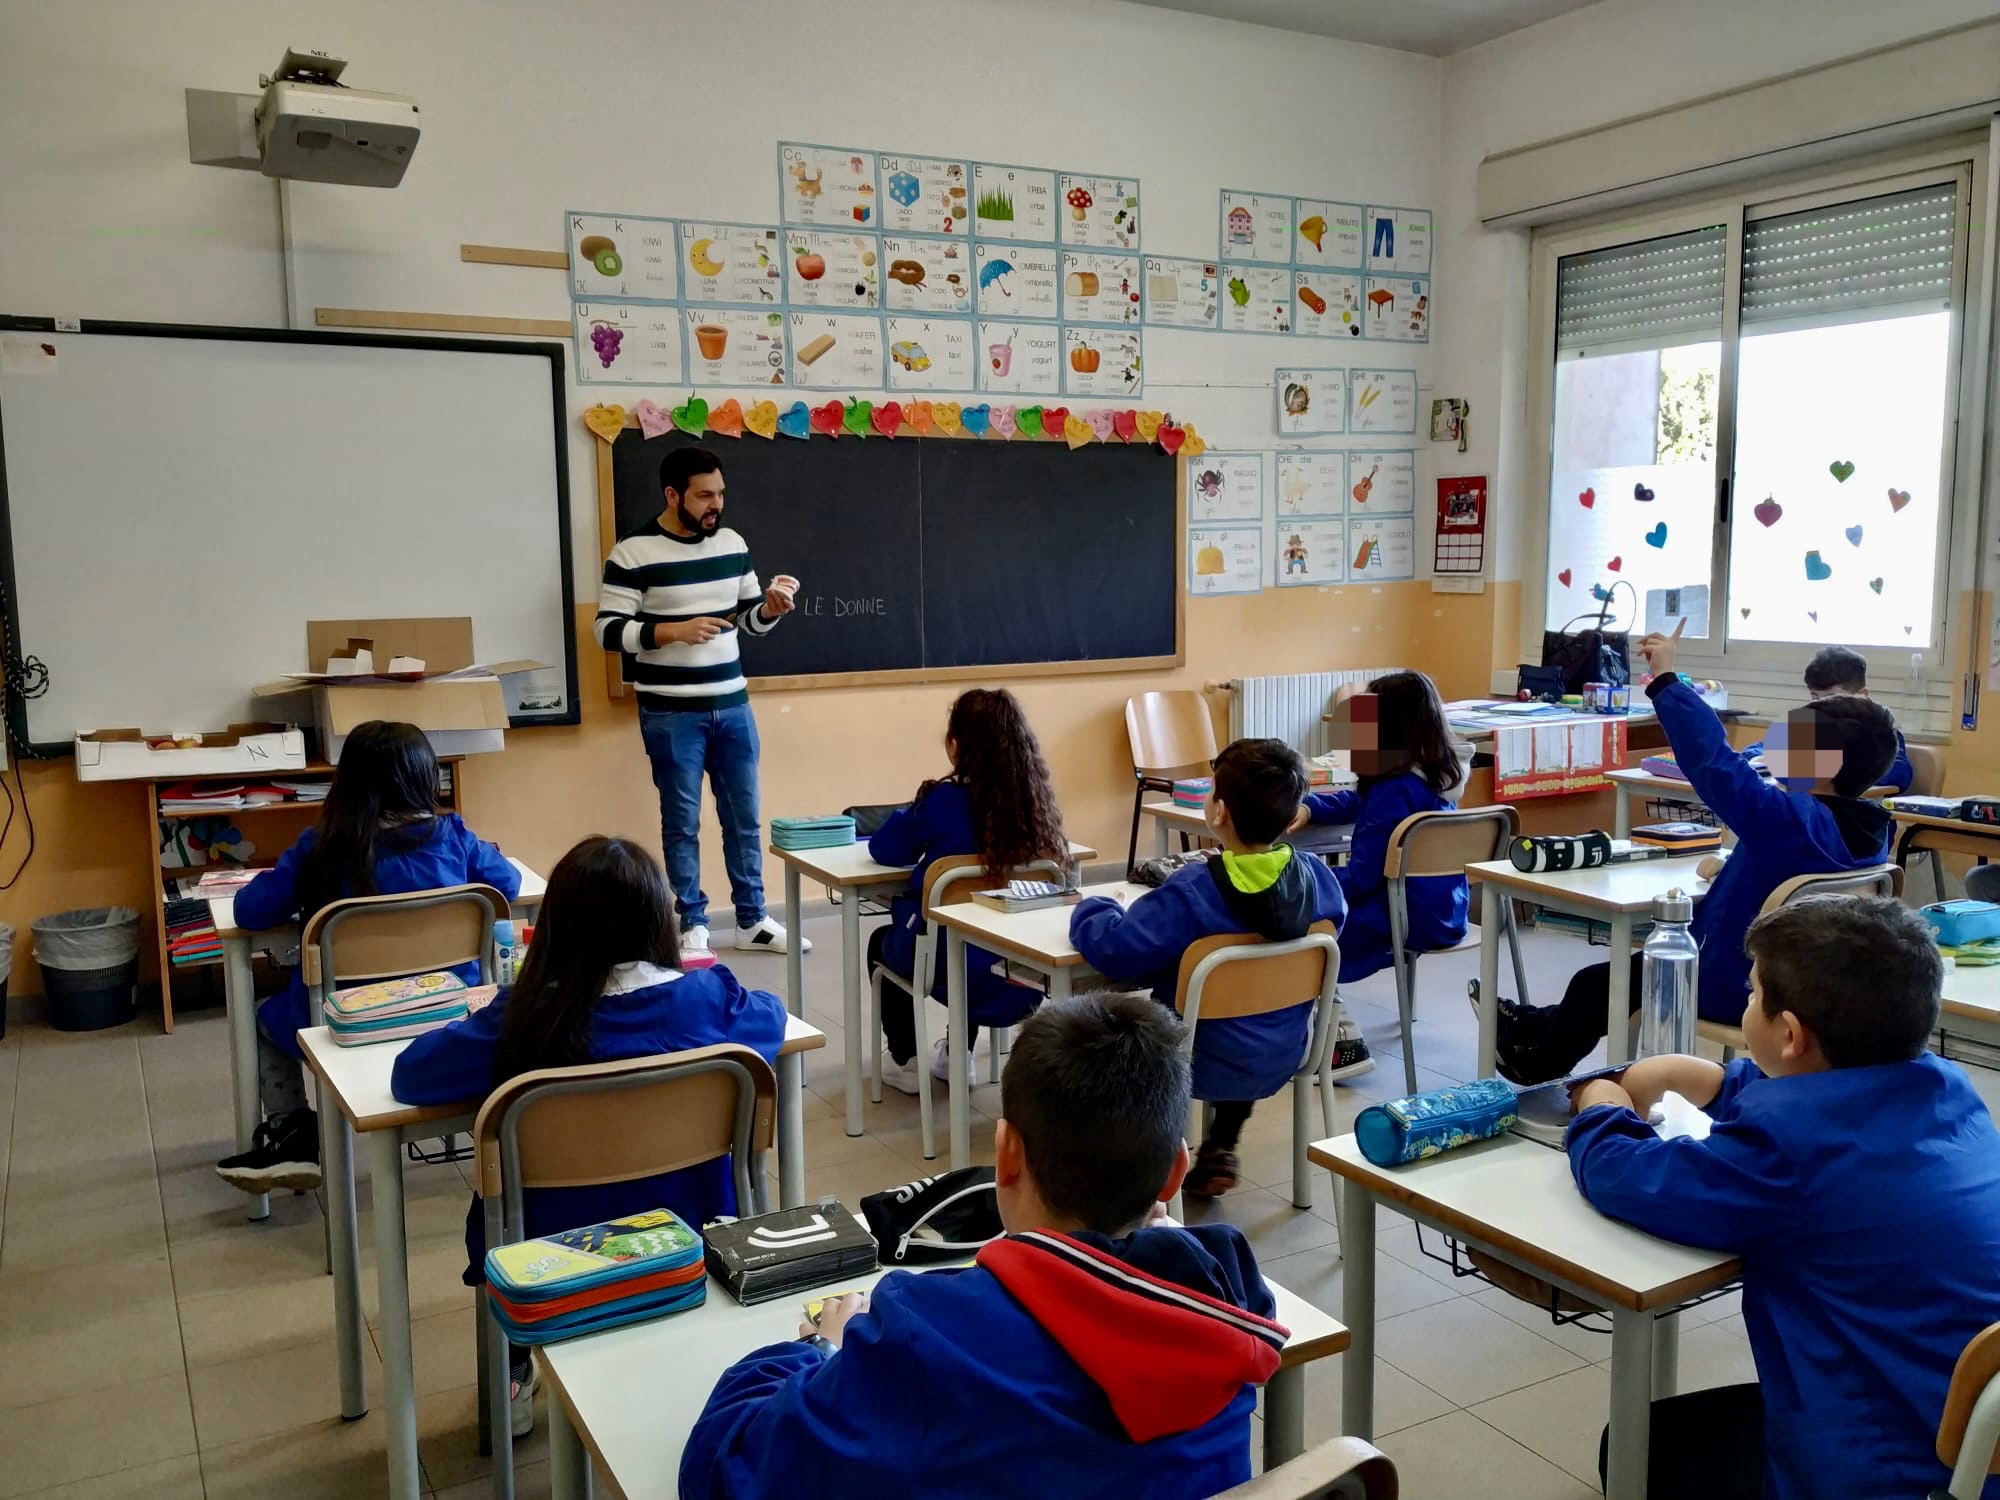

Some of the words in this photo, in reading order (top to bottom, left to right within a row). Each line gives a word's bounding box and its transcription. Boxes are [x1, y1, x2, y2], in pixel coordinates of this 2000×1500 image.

[310, 49, 329, 57] NEC
[783, 148, 801, 161] Cc
[882, 158, 898, 170] Dd
[975, 166, 982, 178] E
[1027, 186, 1047, 195] ERBA
[1223, 194, 1230, 204] H
[573, 217, 583, 230] K
[615, 220, 623, 233] k
[642, 237, 663, 247] KIWI
[786, 233, 807, 246] Mm
[884, 240, 899, 252] Nn
[976, 246, 985, 256] O
[1010, 250, 1017, 259] o
[1064, 254, 1078, 266] Pp
[1019, 261, 1057, 272] OMBRELLO
[1145, 260, 1161, 273] Qq
[1223, 266, 1232, 277] Rr
[1296, 274, 1309, 285] Ss
[578, 304, 589, 317] U
[619, 309, 627, 318] u
[687, 311, 704, 323] Vv
[791, 314, 803, 325] W
[826, 318, 837, 327] w
[889, 319, 897, 330] X
[924, 322, 930, 331] x
[648, 324, 666, 332] UVA
[980, 324, 988, 334] Y
[1013, 327, 1019, 338] y
[847, 332, 876, 340] WAFER
[946, 335, 962, 343] TAXI
[1066, 330, 1080, 341] Zz
[1026, 340, 1056, 349] YOGURT
[1192, 532, 1204, 541] GLI
[804, 596, 824, 616] LE
[835, 596, 887, 617] DONNE
